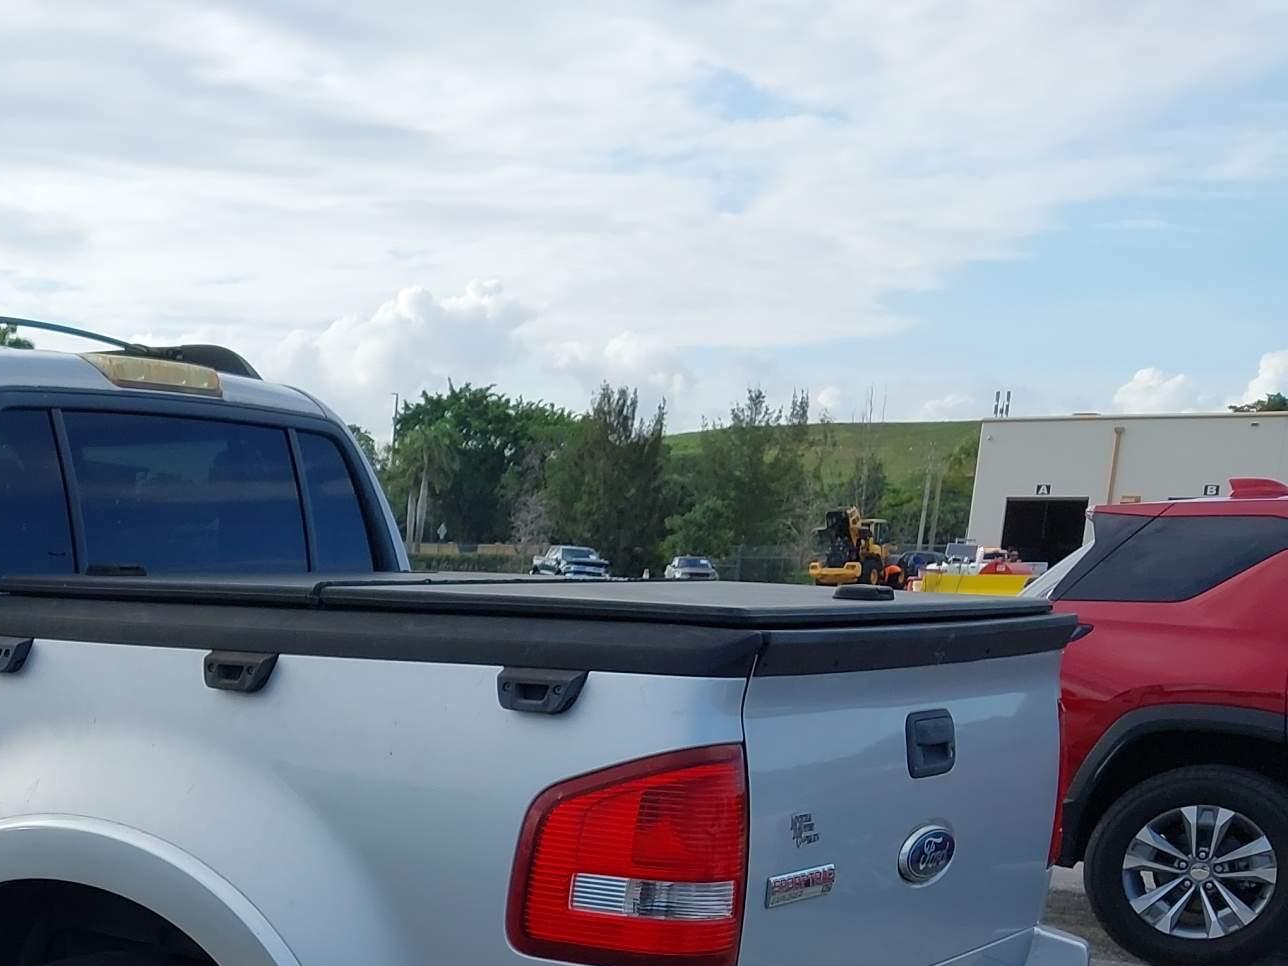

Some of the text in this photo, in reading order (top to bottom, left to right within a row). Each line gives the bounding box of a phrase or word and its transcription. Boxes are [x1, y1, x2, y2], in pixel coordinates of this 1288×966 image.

[1038, 485, 1048, 495] A
[1207, 485, 1217, 495] B
[919, 836, 951, 871] Ford
